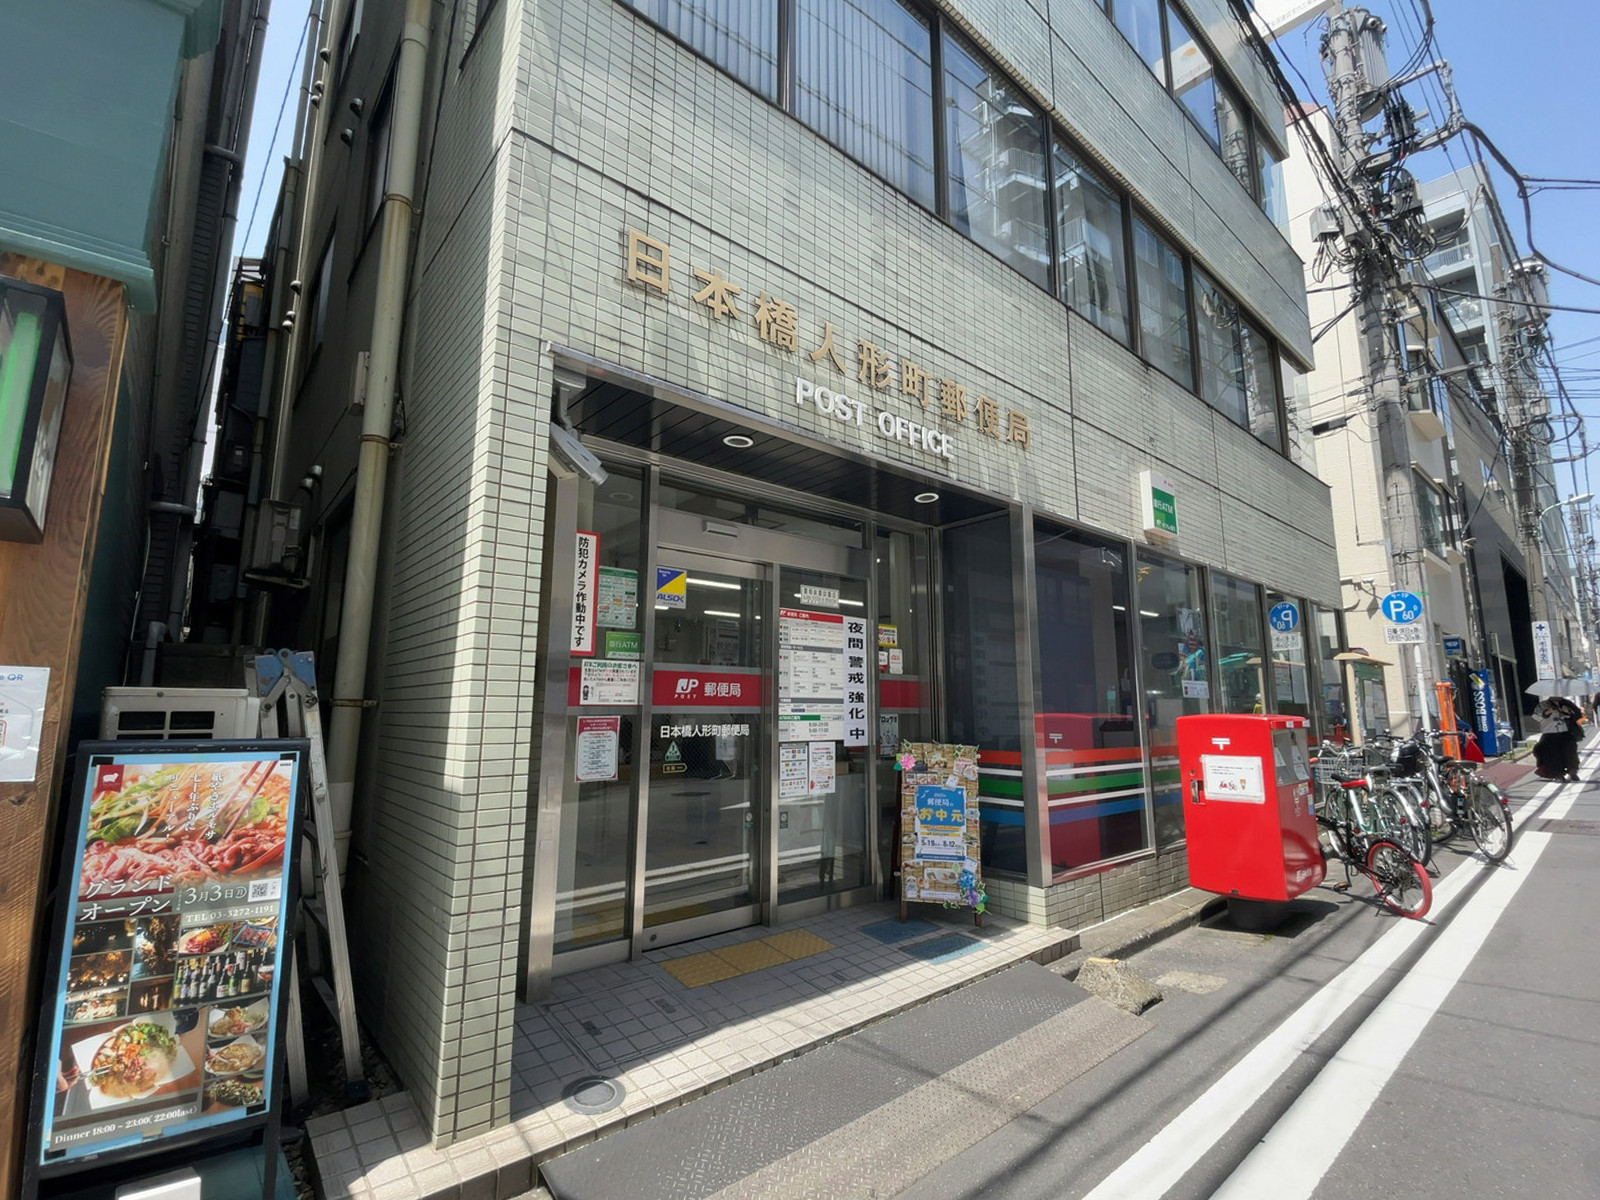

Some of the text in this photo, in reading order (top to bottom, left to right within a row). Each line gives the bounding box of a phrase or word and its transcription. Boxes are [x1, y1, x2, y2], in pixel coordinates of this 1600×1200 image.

[627, 228, 1031, 449] 日本橋人形町郵便局
[796, 378, 957, 461] POST OFFICE
[574, 537, 589, 647] 防犯カメラ作動中です
[656, 593, 685, 603] ALSOK
[1390, 600, 1406, 621] P
[704, 682, 741, 698] 郵便局
[847, 622, 865, 740] 夜間警戒強化中
[1473, 690, 1487, 715] BOSS
[660, 723, 750, 739] 日本橋人形町郵便局
[920, 808, 964, 823] お中元
[85, 875, 172, 899] グランド
[80, 895, 171, 921] オープン
[185, 913, 208, 923] TEL
[54, 1129, 91, 1145] Dinner
[92, 1124, 116, 1136] 18:00
